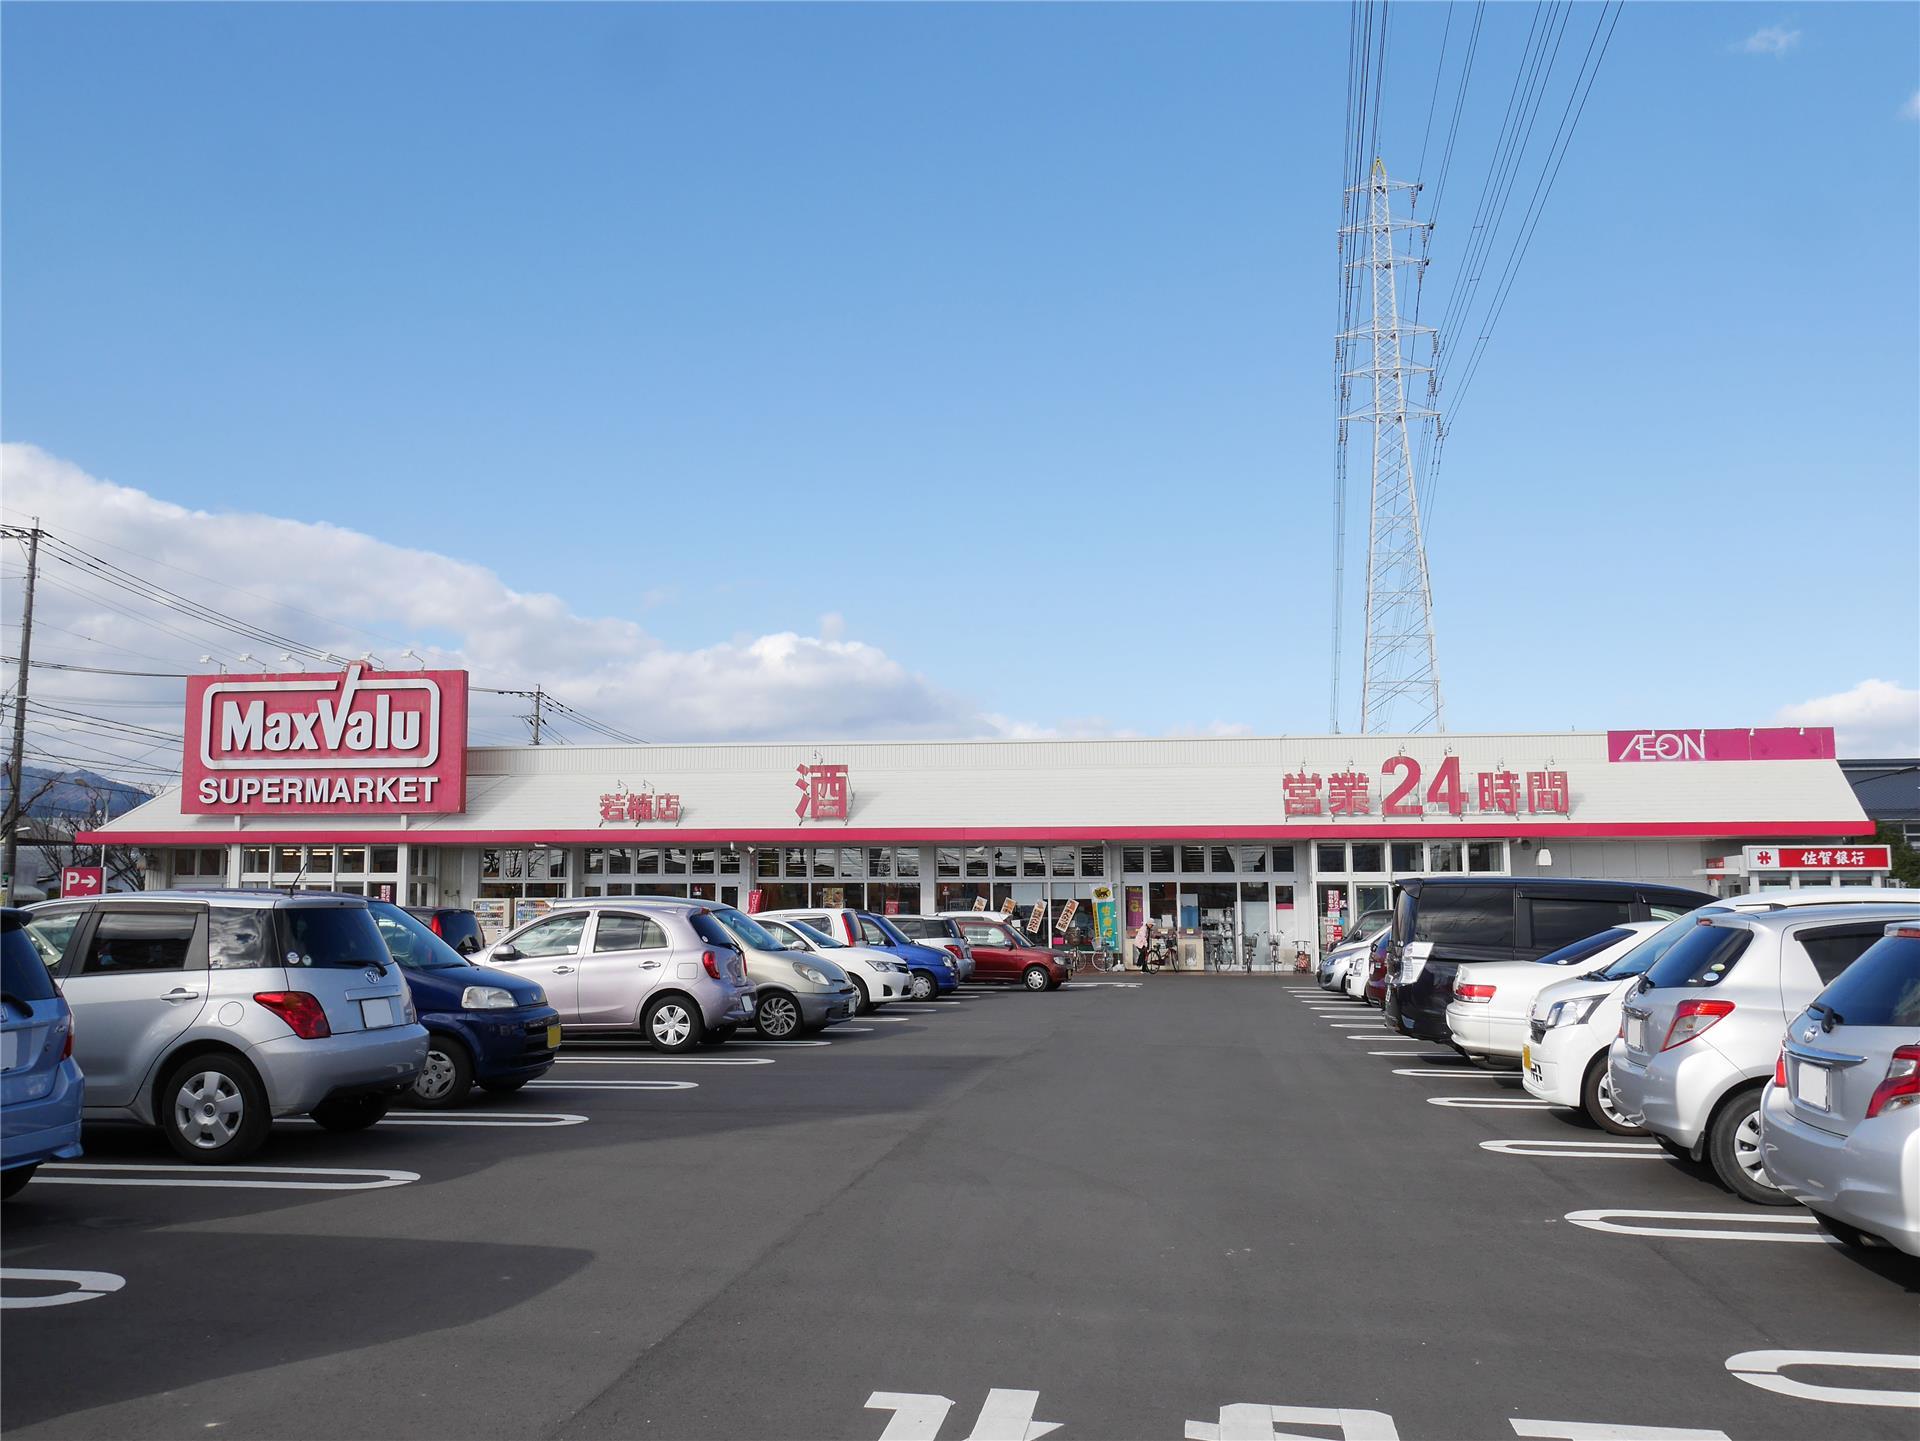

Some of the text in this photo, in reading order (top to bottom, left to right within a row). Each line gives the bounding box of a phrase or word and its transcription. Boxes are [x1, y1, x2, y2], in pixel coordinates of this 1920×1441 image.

[221, 664, 420, 751] MaxValu
[199, 776, 439, 804] SUPERMARKET
[795, 763, 849, 819] 酒
[1283, 756, 1569, 816] 営業24時間
[600, 794, 680, 821] 若楠店
[1801, 850, 1866, 865] 佐賀銀行
[66, 872, 79, 890] P
